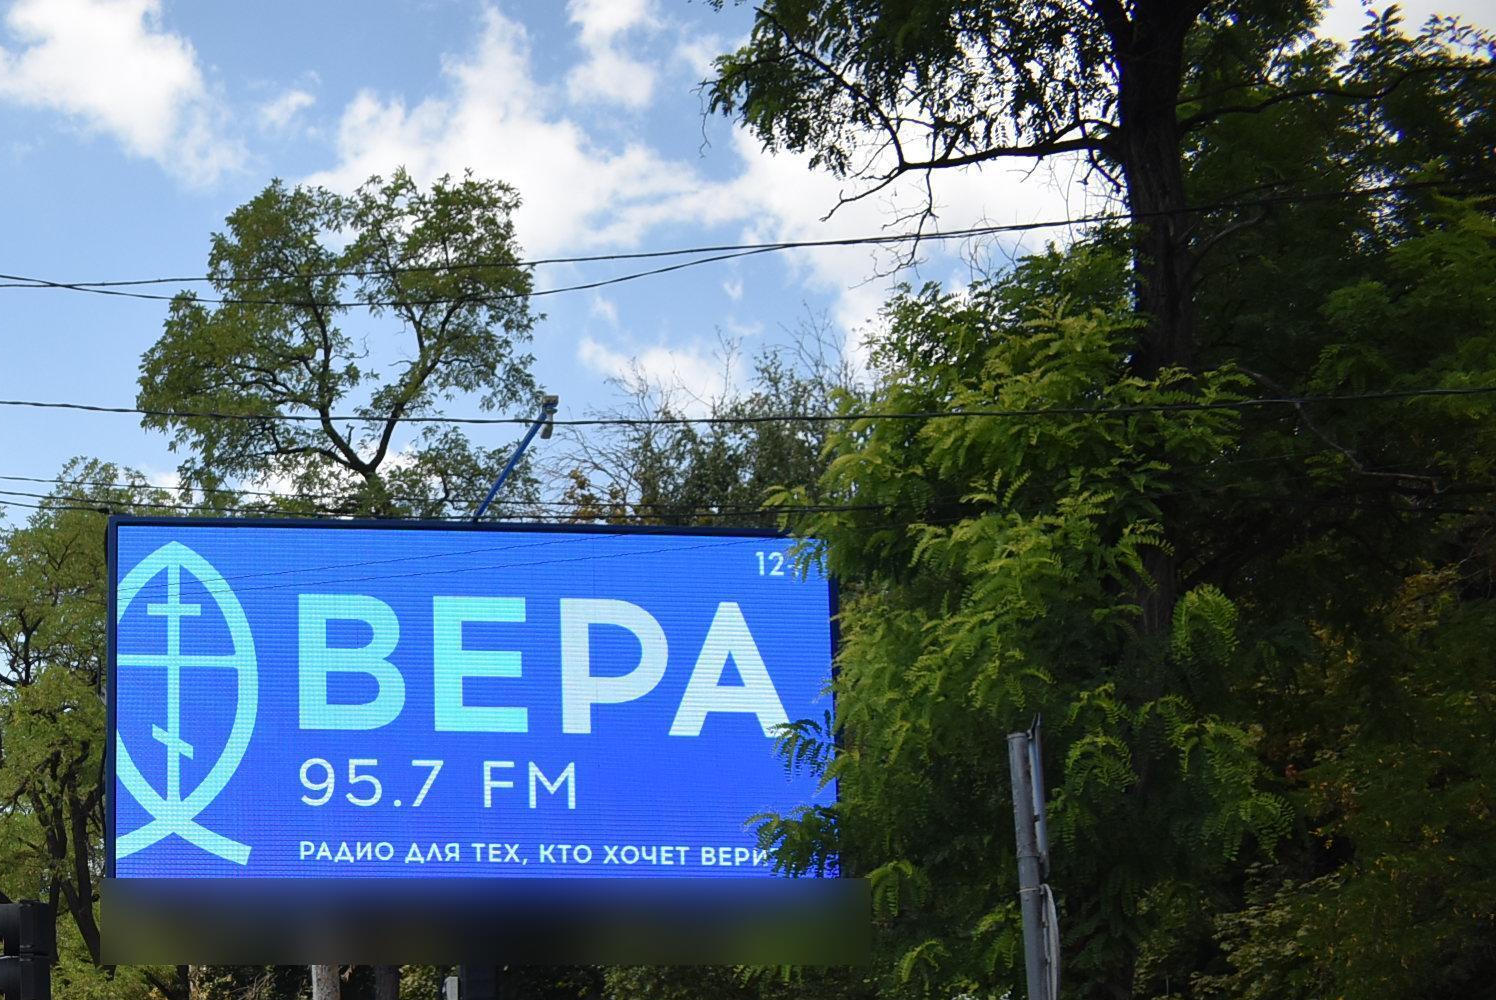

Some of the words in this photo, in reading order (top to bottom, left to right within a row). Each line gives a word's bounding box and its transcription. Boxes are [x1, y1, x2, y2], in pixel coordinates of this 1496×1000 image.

[298, 593, 792, 738] ВЕРА
[299, 757, 444, 808] 95.7
[484, 761, 576, 810] FM
[299, 841, 395, 864] РАДИО
[404, 842, 460, 864] ДЛЯ
[470, 842, 528, 867] ТЕХ,
[538, 843, 593, 864] КТО
[603, 845, 690, 866] ХОЧЕТ
[701, 846, 778, 867] ВЕРИ
